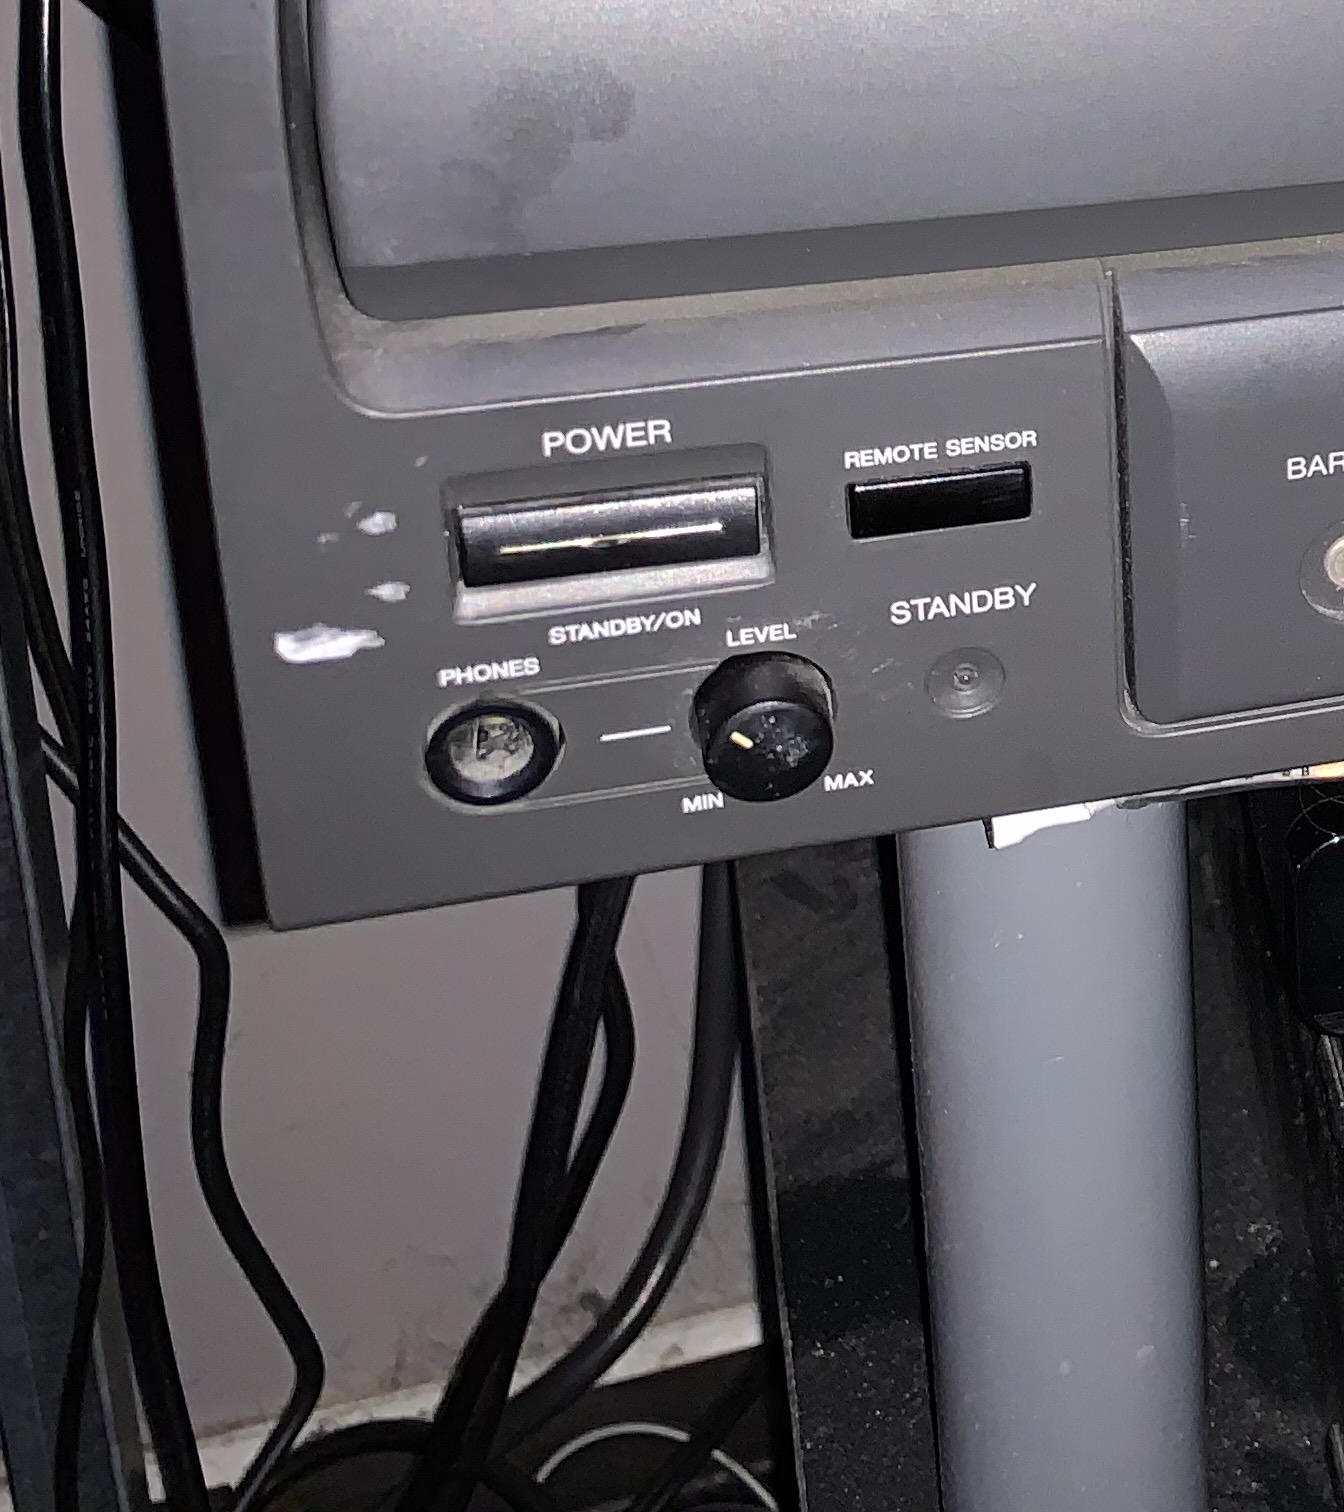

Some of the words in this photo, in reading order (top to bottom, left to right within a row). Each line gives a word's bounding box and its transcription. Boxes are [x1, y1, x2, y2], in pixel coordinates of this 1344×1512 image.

[542, 419, 673, 457] POWER
[844, 441, 939, 470] REMOTE
[945, 430, 1038, 457] SENSOR
[889, 582, 1038, 626] STANDBY
[548, 608, 702, 645] STANDBY/ON
[726, 623, 797, 647] LEVEL
[438, 657, 541, 687] PHONES
[823, 769, 875, 792] MAX
[681, 792, 725, 814] MIN
